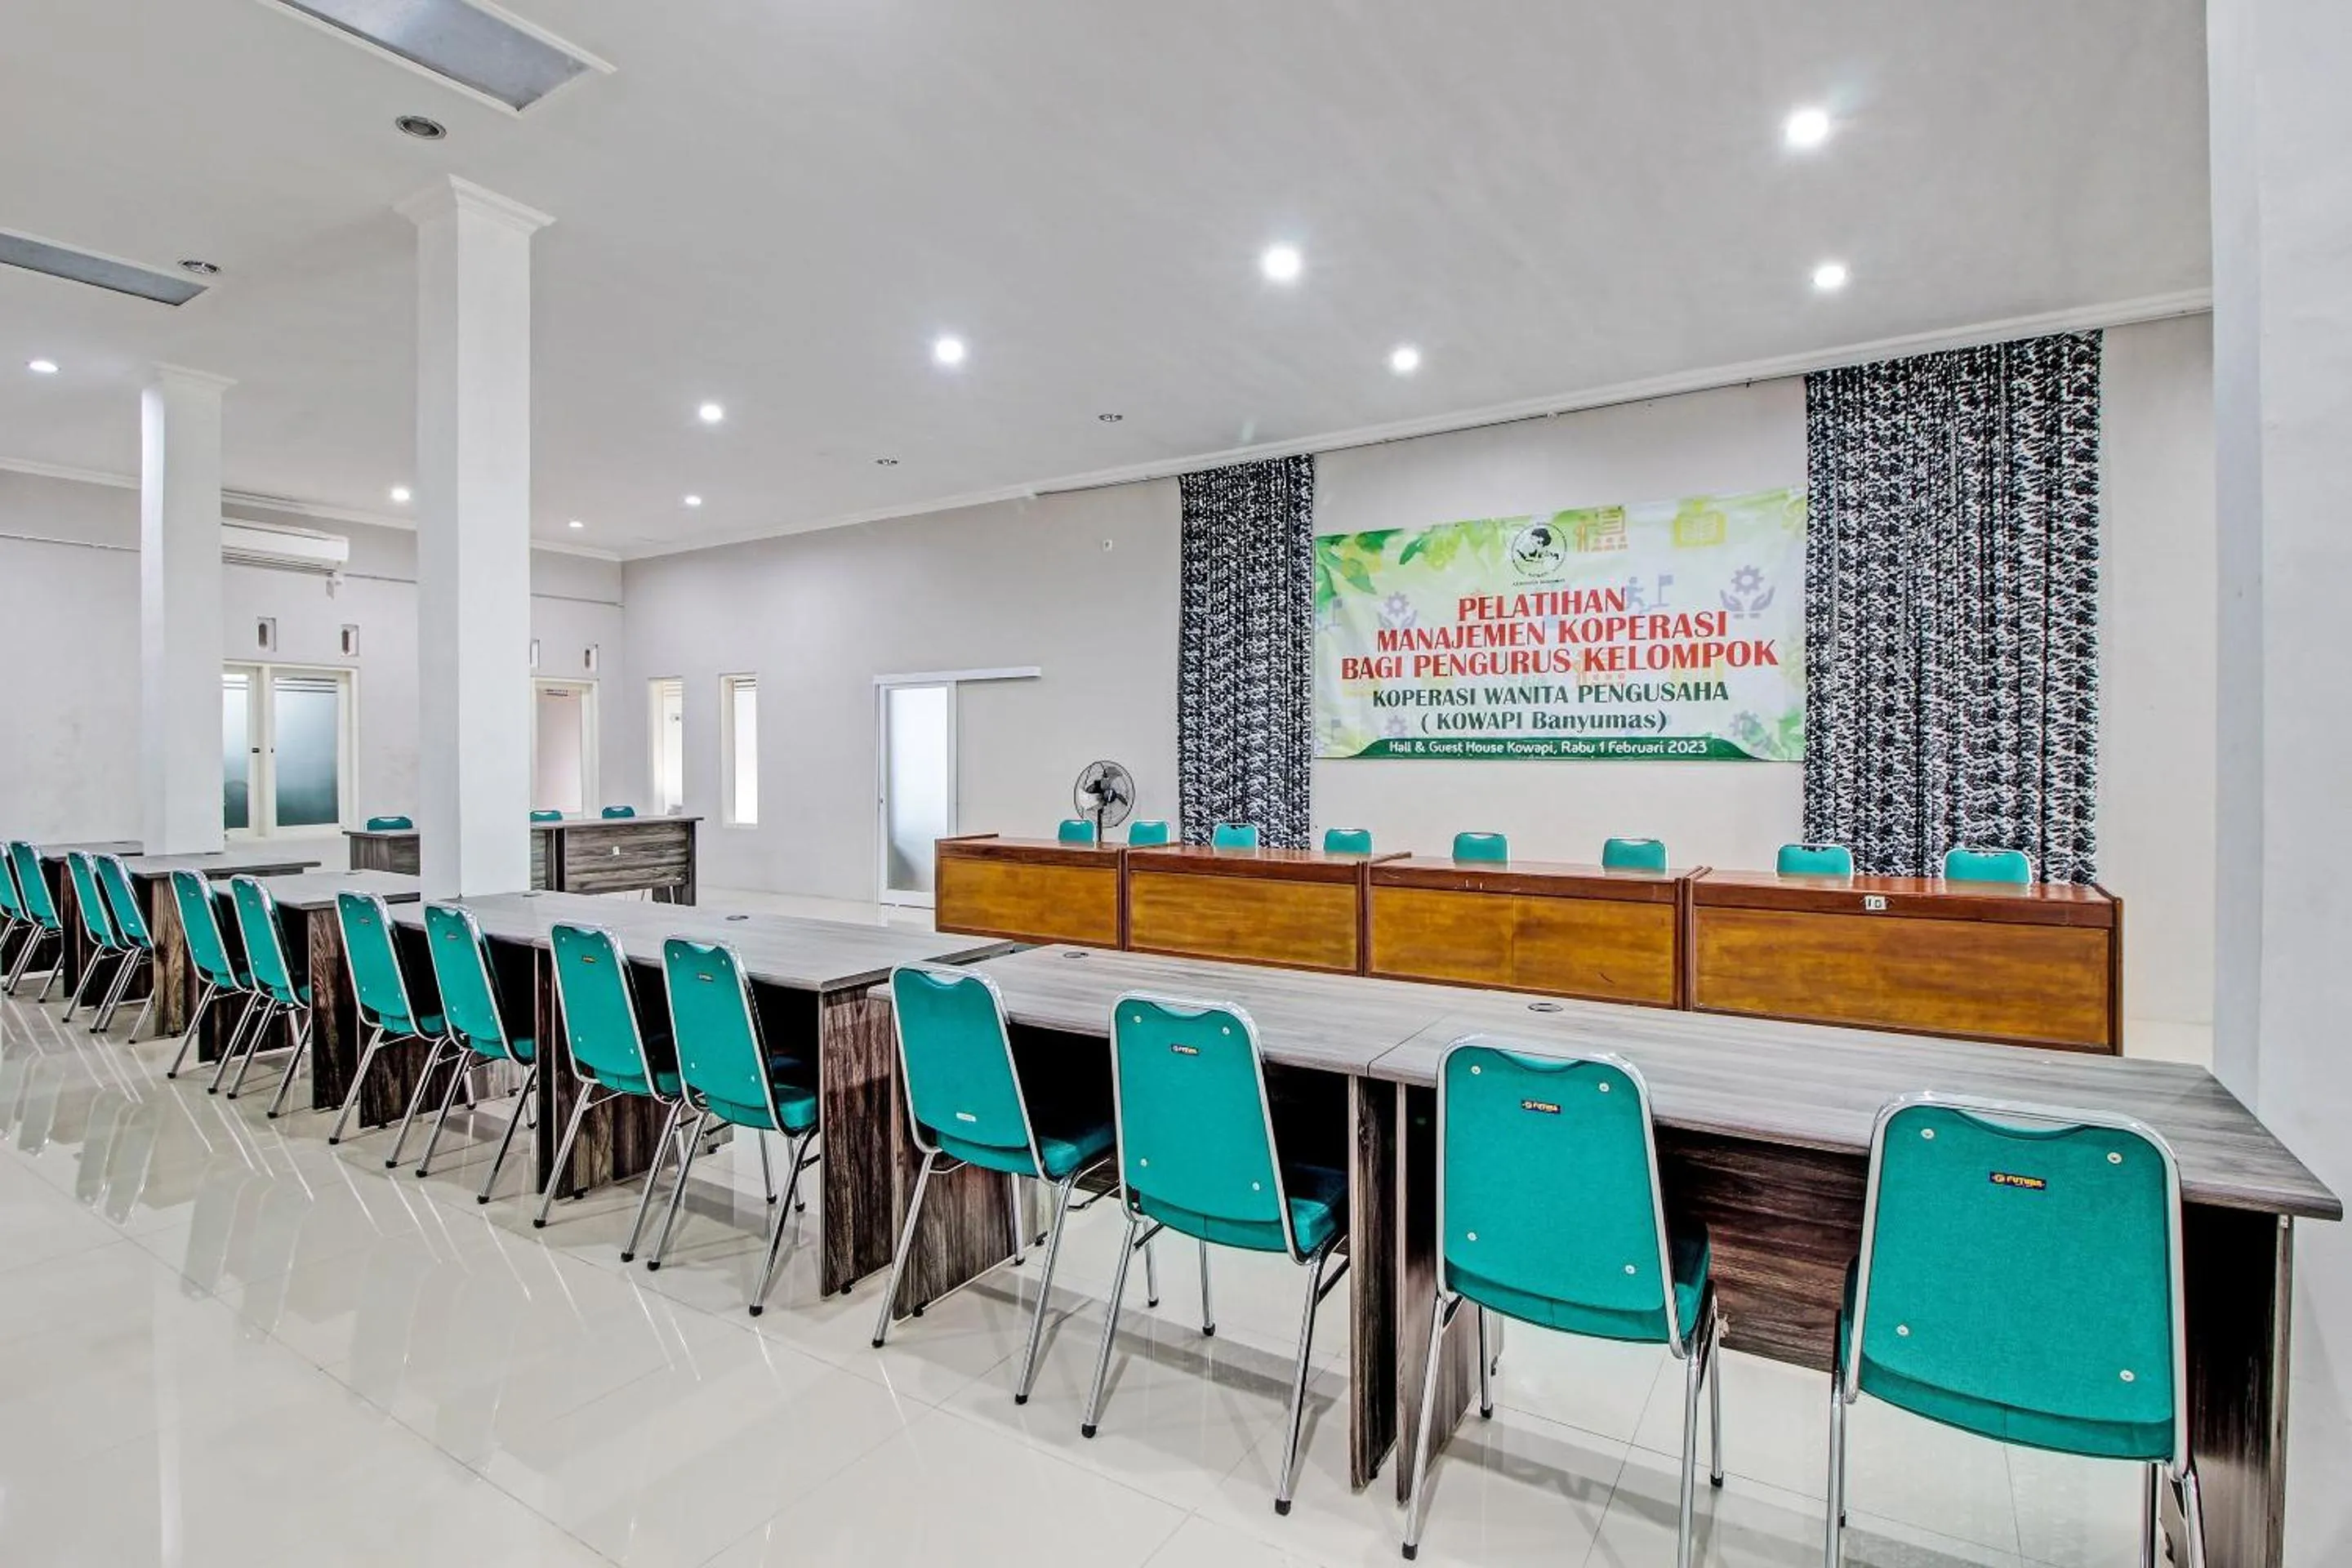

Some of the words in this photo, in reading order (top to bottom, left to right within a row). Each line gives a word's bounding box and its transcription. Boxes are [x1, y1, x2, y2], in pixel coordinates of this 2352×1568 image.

[1459, 586, 1625, 621] PELATIHAN
[1377, 621, 1545, 653] MANAJEMEN
[1558, 611, 1727, 644] KOPERASI
[1341, 656, 1403, 679] BAGI
[1414, 648, 1572, 679] PENGURUS
[1584, 639, 1780, 673] KELOMPOK
[1373, 687, 1477, 708] KOPERASI
[1485, 685, 1569, 706] WANITA
[1578, 681, 1730, 703] PENGUSAHA
[1532, 710, 1668, 733] Banyumas)
[1389, 742, 1412, 753] Hall
[1414, 742, 1425, 753] &
[1429, 742, 1463, 753] Guest
[1466, 742, 1503, 753] House
[1507, 741, 1557, 755] Kowapi,
[1561, 741, 1595, 754] Rabu
[1598, 741, 1606, 753] 1
[1608, 741, 1664, 754] Februari
[1668, 741, 1707, 754] 2023
